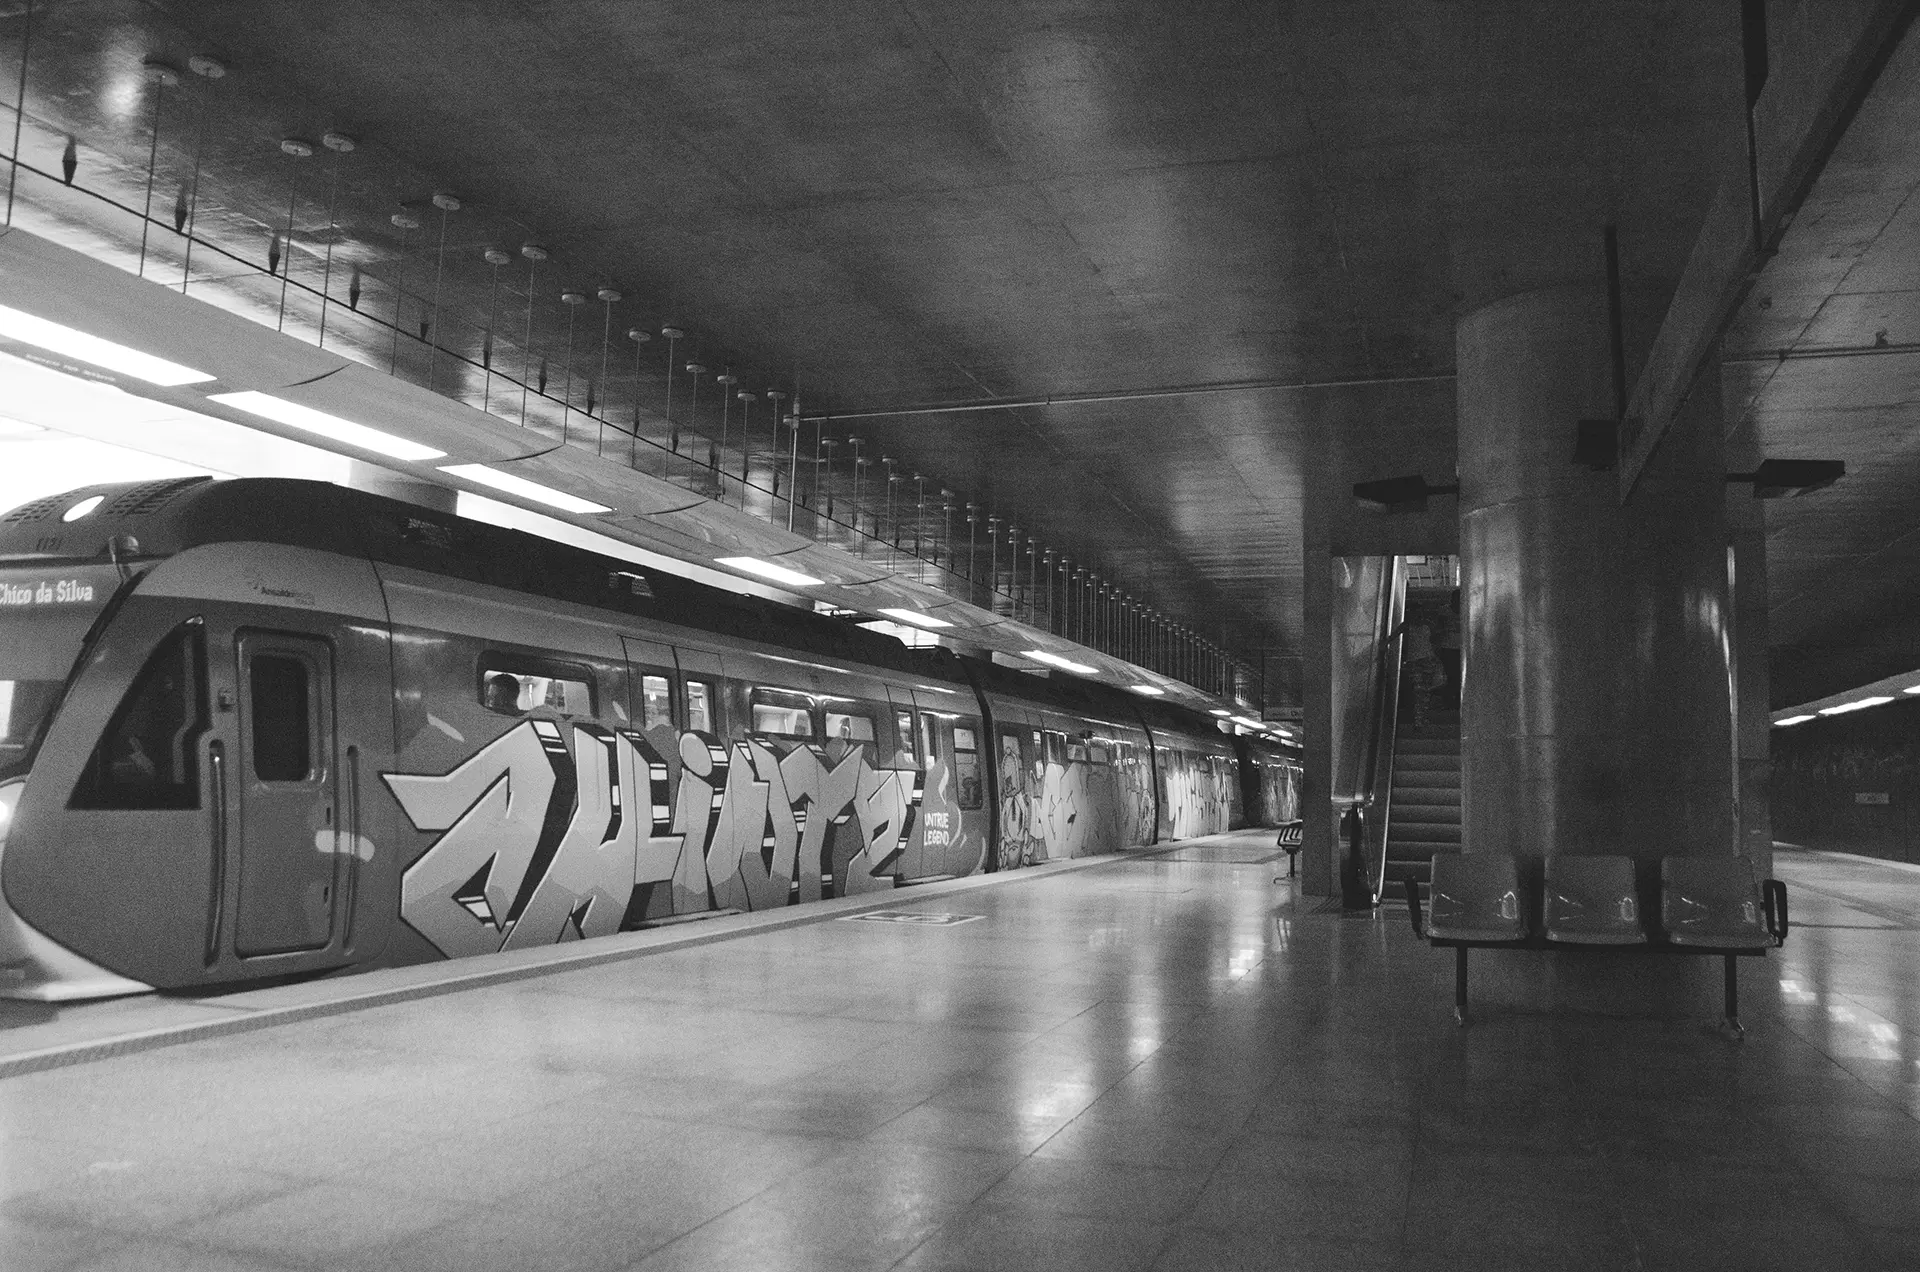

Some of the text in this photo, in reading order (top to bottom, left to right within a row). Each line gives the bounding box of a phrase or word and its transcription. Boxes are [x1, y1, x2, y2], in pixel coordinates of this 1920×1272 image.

[35, 581, 53, 604] da
[56, 579, 93, 603] Silva
[924, 811, 949, 829] UNTRUE
[923, 829, 950, 847] LEGEND
